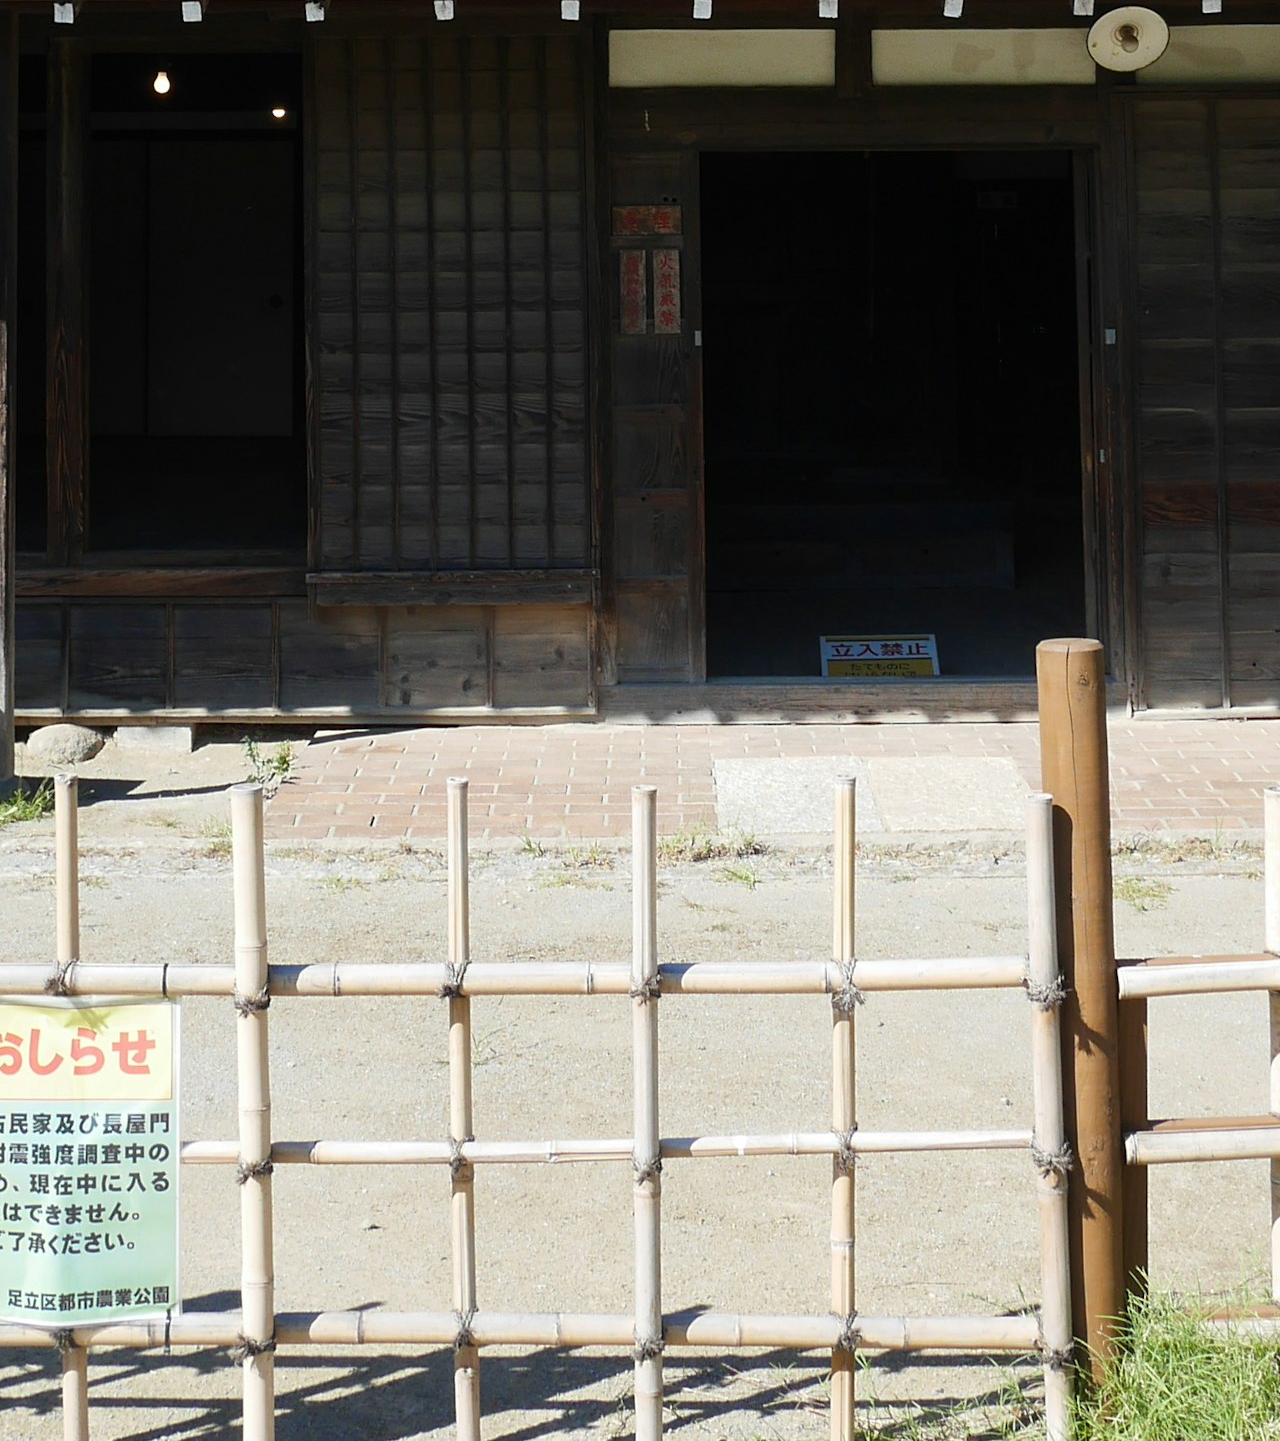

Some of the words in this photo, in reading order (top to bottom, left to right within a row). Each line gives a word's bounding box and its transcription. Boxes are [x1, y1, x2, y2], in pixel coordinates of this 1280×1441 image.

[831, 642, 929, 657] 立入禁止
[850, 662, 910, 671] たてものに
[8, 1285, 170, 1311] 足立区都市農業公園
